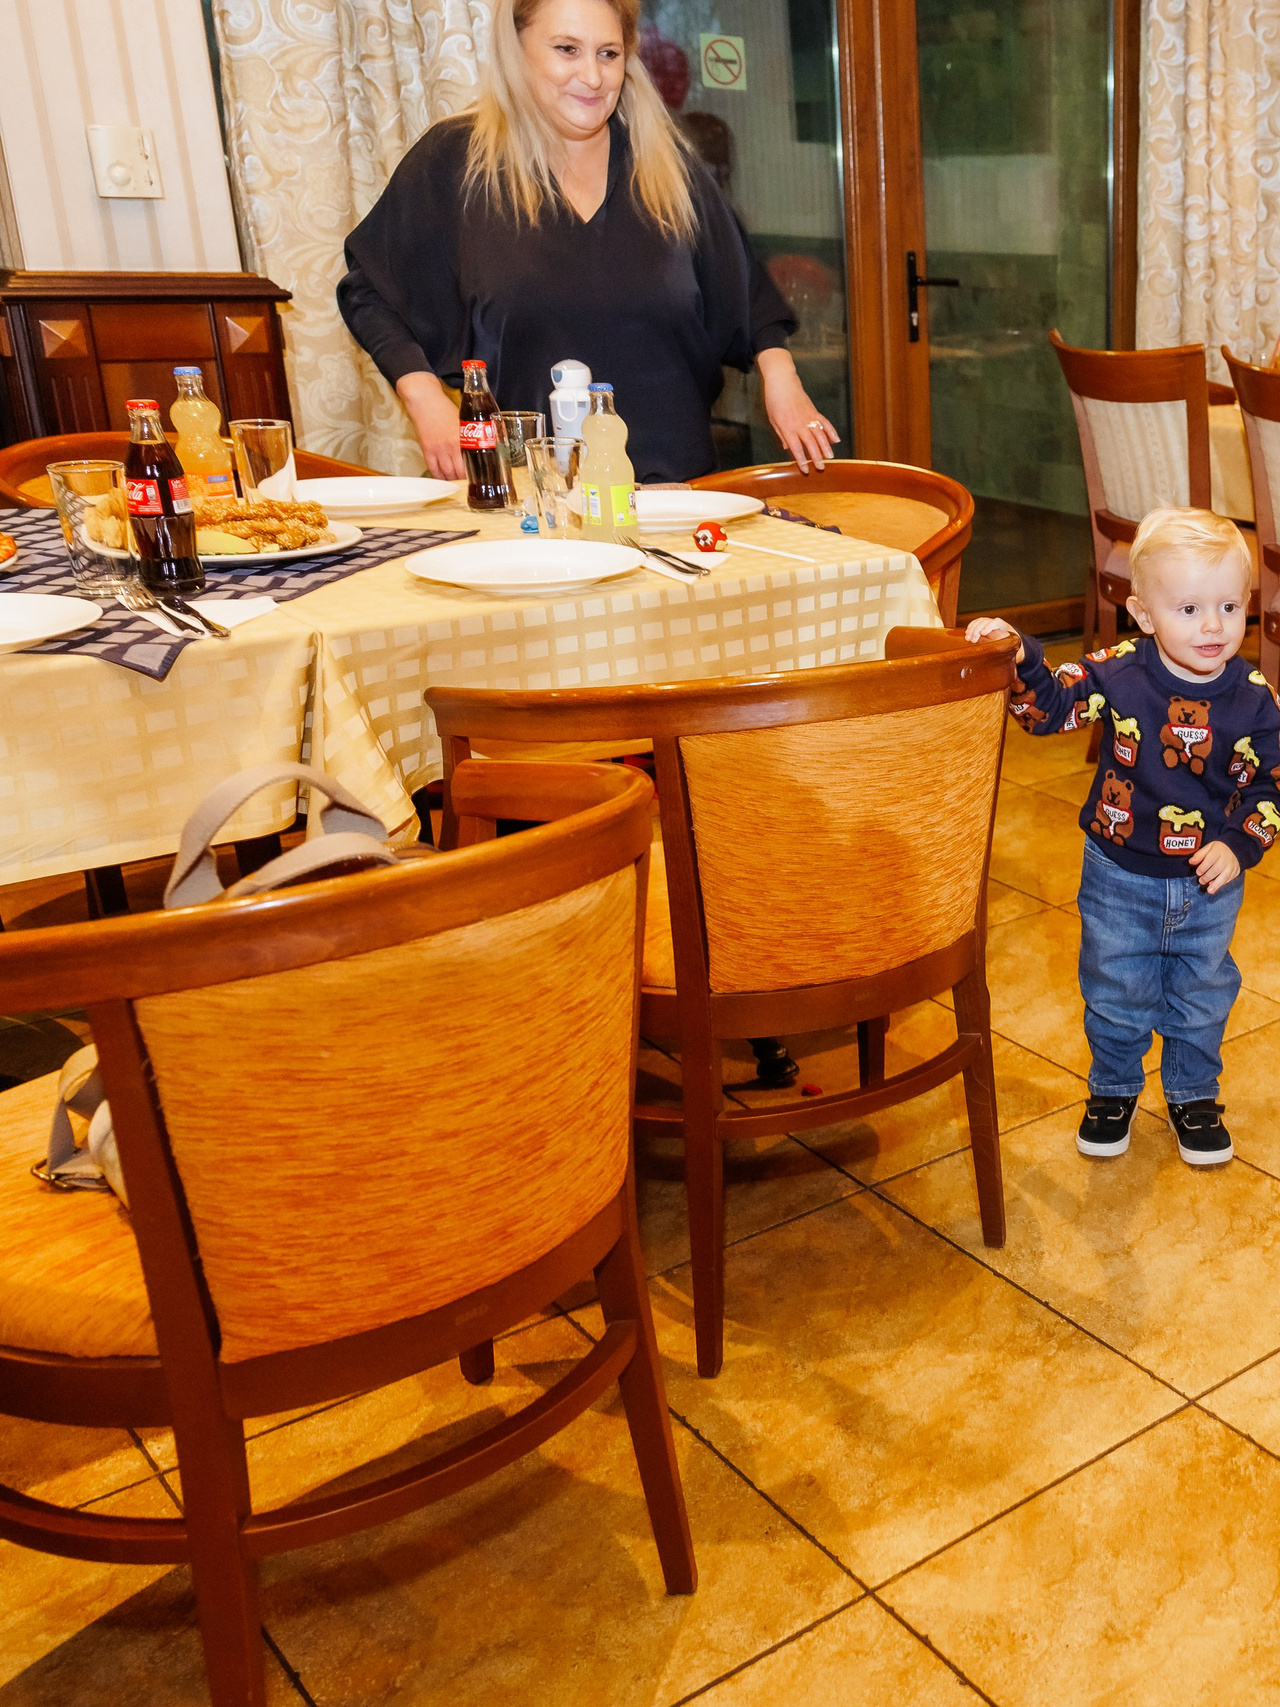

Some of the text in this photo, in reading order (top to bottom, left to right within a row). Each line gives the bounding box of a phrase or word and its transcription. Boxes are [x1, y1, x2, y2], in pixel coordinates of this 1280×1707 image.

[1177, 730, 1205, 740] GUESS
[1105, 808, 1126, 821] GUESS
[1165, 838, 1195, 848] HONEY
